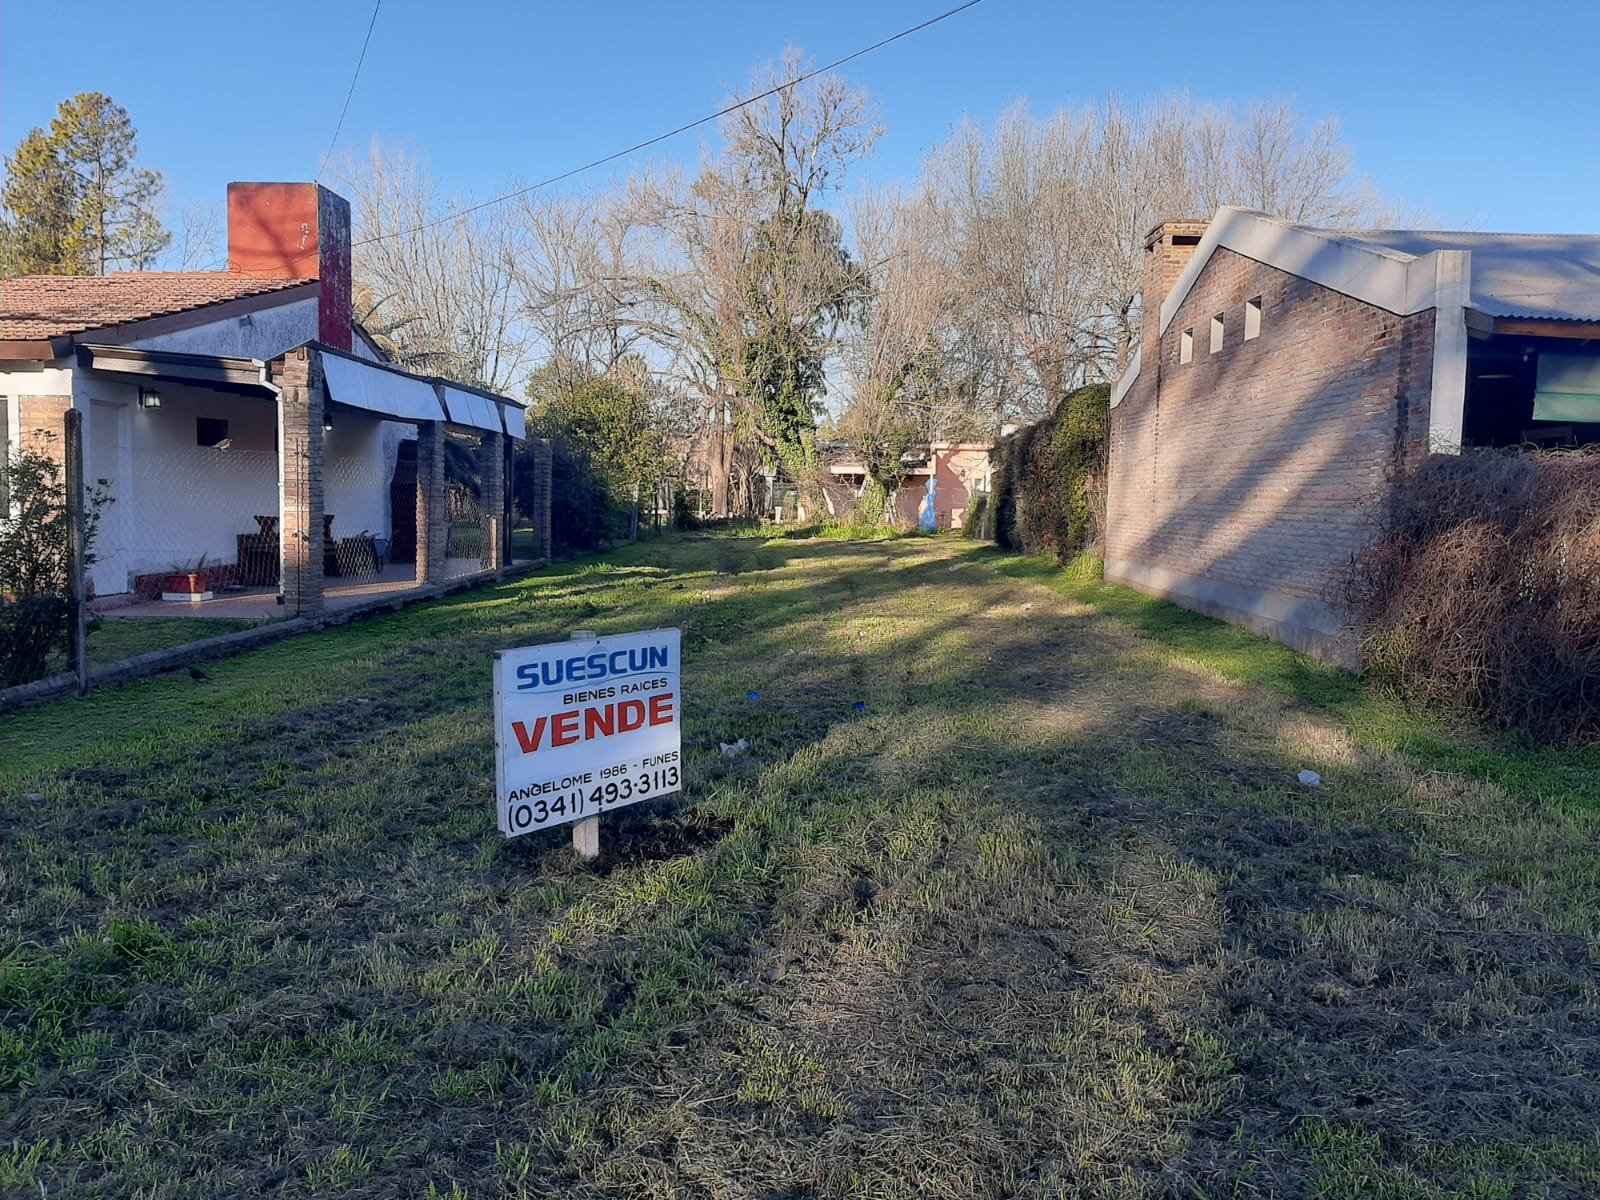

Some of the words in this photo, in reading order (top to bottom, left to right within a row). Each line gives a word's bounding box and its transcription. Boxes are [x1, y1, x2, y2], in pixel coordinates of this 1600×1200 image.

[517, 645, 668, 690] SUESCUN
[563, 687, 616, 705] BIENES
[621, 678, 668, 695] RAICES
[512, 693, 674, 754] VENDE
[508, 772, 593, 803] ANGELOME
[600, 764, 628, 780] 1986
[642, 751, 679, 769] FUNES
[508, 788, 584, 832] (0341)
